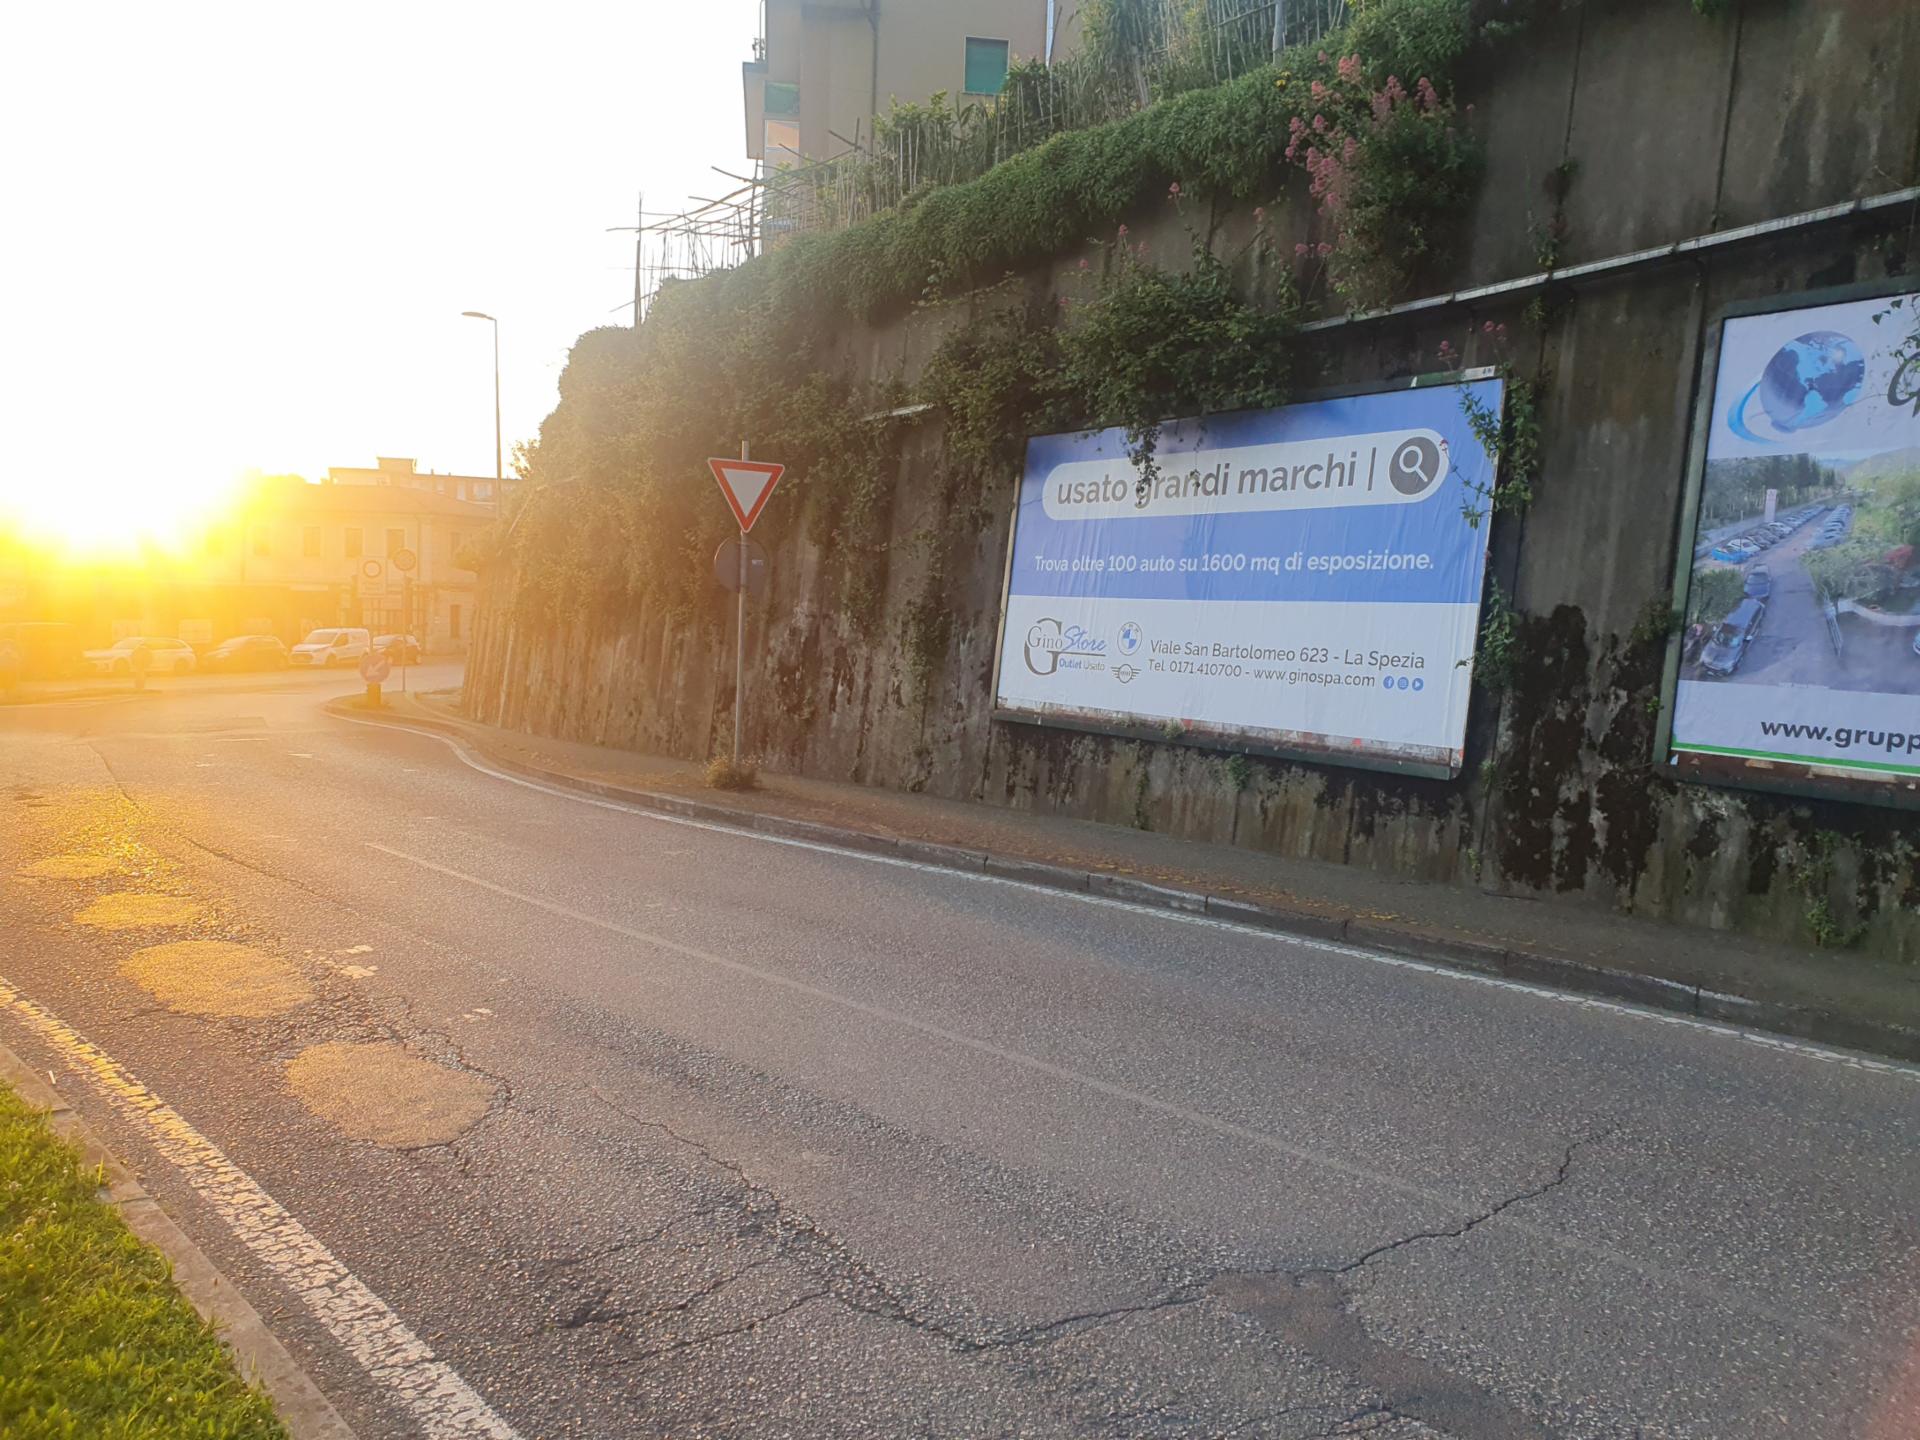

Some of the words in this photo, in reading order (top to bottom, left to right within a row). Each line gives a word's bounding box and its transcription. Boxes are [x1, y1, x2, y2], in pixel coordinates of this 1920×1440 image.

[1057, 474, 1128, 505] usato
[1134, 462, 1231, 509] grandi
[1237, 451, 1357, 494] marchi
[1035, 555, 1069, 572] Trova
[1072, 554, 1104, 572] oltre
[1108, 555, 1137, 572] 100
[1140, 554, 1175, 572] auto
[1178, 557, 1198, 572] su
[1201, 553, 1246, 572] 1600
[1250, 554, 1280, 576] mq
[1284, 551, 1302, 571] di
[1307, 549, 1434, 576] esposizione.
[1027, 625, 1063, 650] Gino
[1062, 625, 1107, 652] Store
[1059, 658, 1082, 670] Outlet
[1150, 640, 1181, 655] Viale
[1184, 641, 1208, 657] San
[1212, 642, 1296, 661] Bartolomeo
[1300, 647, 1329, 663] 623
[1344, 649, 1364, 665] La
[1367, 650, 1425, 671] Spezia
[1254, 668, 1376, 687] www.ginospa.com
[1760, 721, 1920, 755] www.grupp
